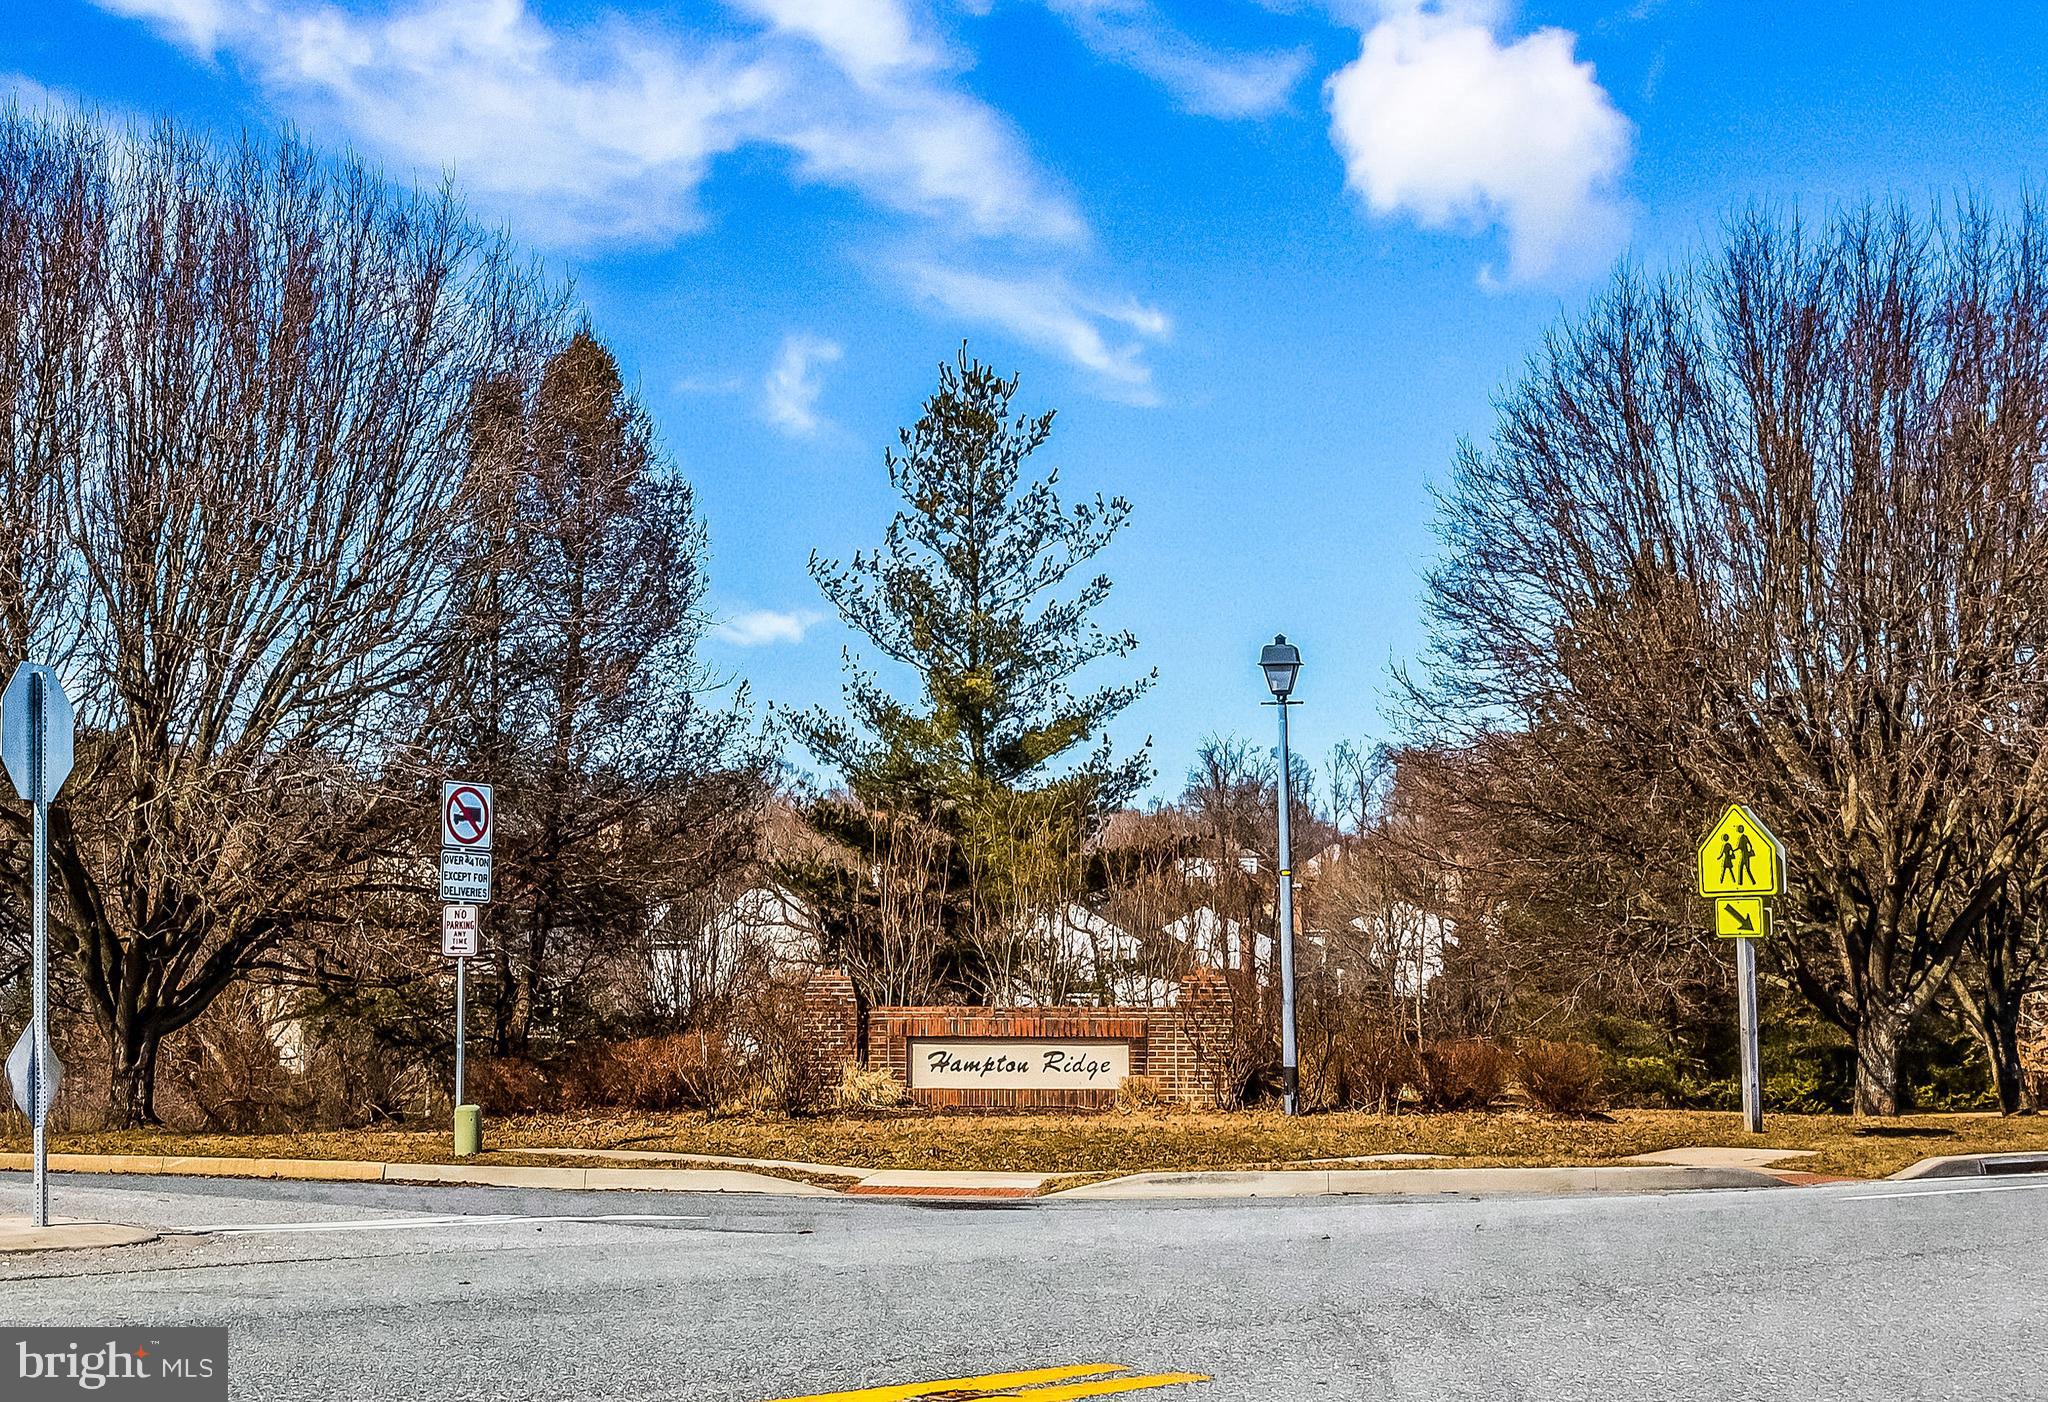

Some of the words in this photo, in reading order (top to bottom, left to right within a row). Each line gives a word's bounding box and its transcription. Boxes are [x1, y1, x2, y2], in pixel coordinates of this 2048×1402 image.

[444, 855, 464, 865] OVER
[475, 857, 489, 868] TON
[444, 871, 471, 882] EXCEPT
[474, 873, 487, 883] FOR
[444, 886, 487, 898] DELIVERIES
[454, 910, 467, 919] NO
[446, 921, 475, 930] PARKING
[927, 1051, 1030, 1077] Hampton
[1042, 1050, 1111, 1080] Ridge
